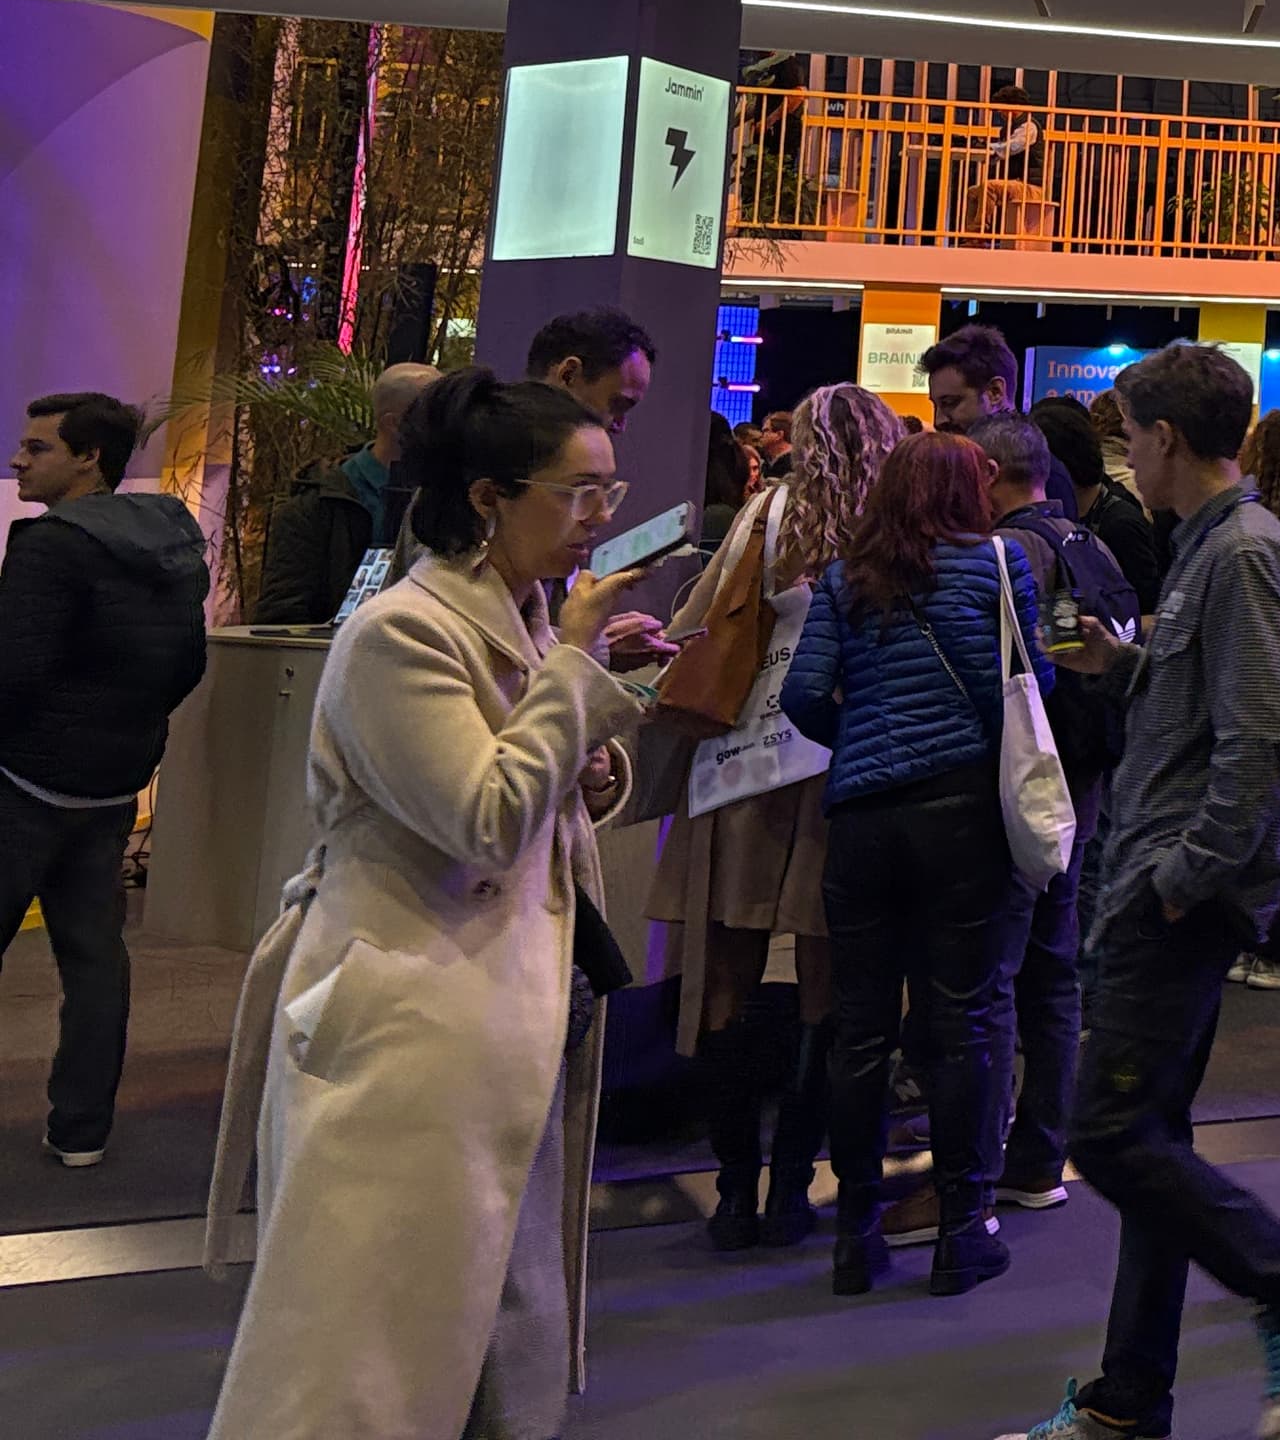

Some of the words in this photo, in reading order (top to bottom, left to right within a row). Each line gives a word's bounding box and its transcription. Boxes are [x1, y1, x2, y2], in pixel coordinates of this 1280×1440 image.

[665, 76, 705, 103] Jammin'
[868, 351, 918, 365] BRAIN
[1047, 359, 1121, 380] Innova
